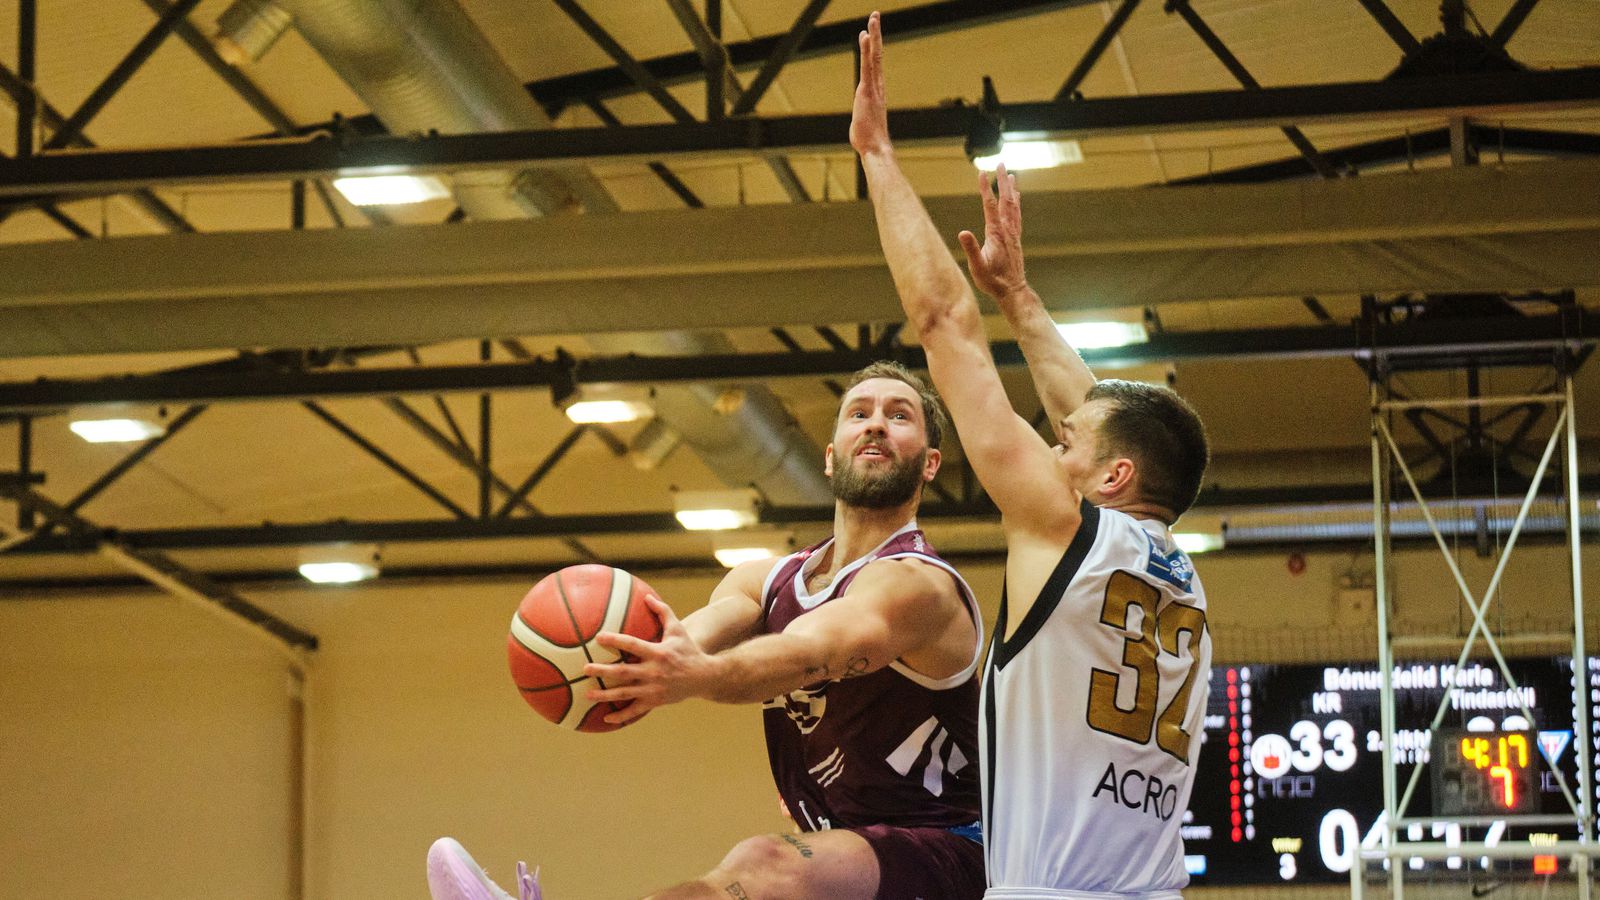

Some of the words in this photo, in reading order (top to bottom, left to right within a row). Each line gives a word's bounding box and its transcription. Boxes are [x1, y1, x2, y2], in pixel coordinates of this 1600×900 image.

[1087, 569, 1208, 766] 32
[1441, 664, 1493, 688] Karla
[1313, 692, 1342, 713] KR
[1290, 719, 1357, 771] 33
[1461, 734, 1528, 769] 4:17
[1092, 762, 1177, 821] ACRO
[1490, 766, 1514, 807] 7
[1279, 853, 1297, 880] 3
